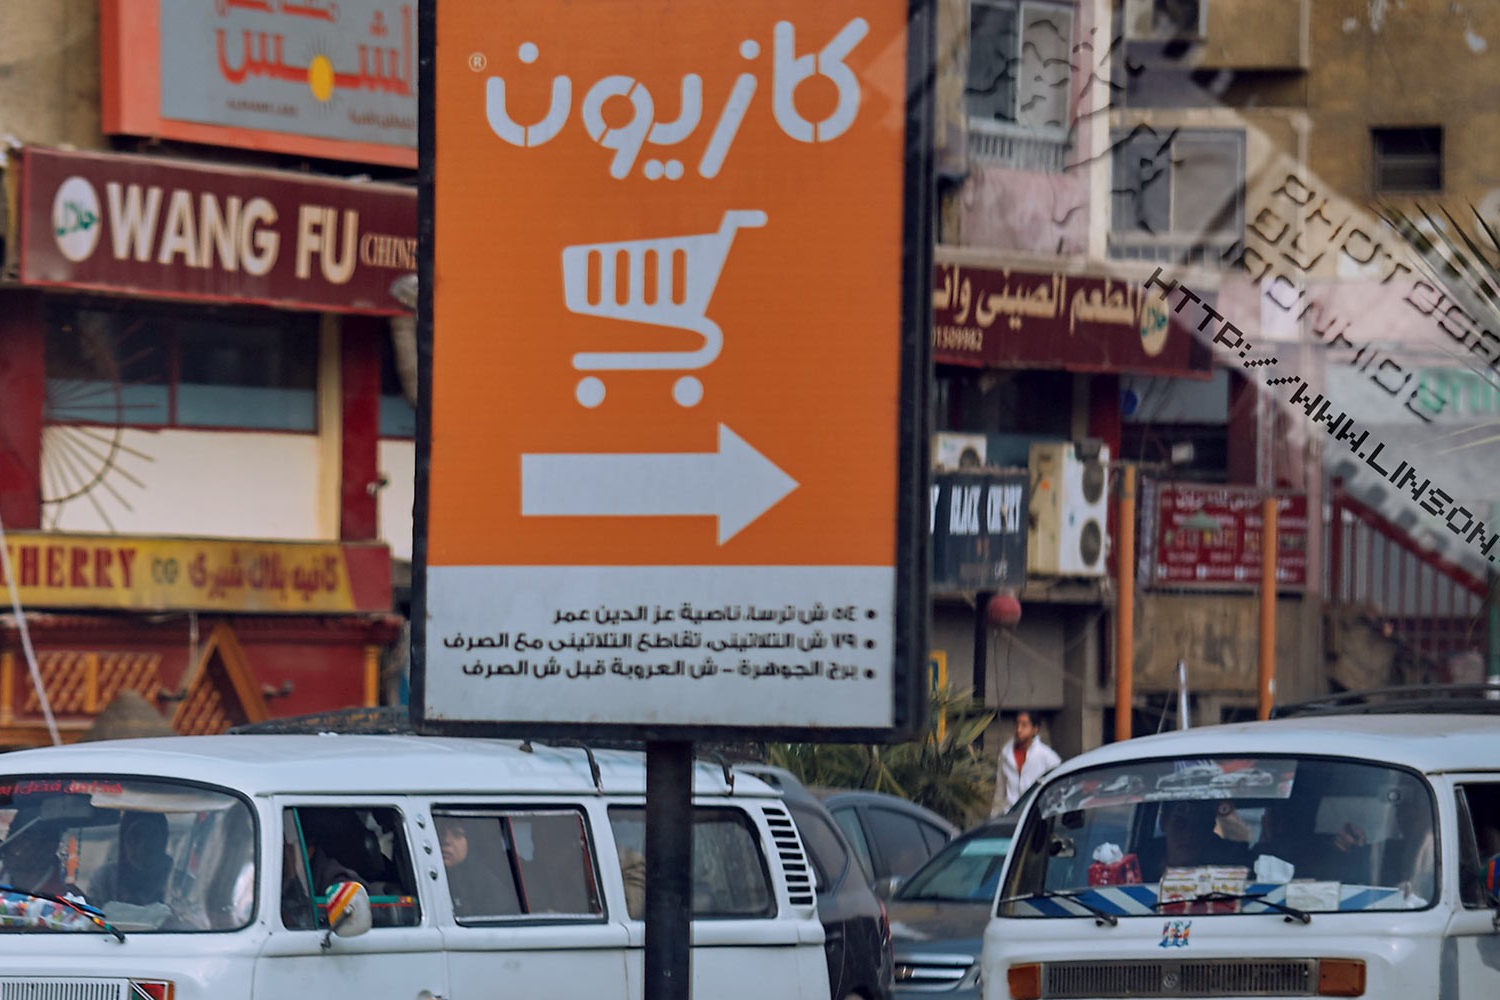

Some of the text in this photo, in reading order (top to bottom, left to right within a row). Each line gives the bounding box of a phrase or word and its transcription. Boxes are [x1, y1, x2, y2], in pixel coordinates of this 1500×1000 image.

[486, 17, 870, 180] كازيون
[106, 182, 281, 276] WANG
[295, 203, 359, 284] FU
[553, 608, 590, 624] عمر
[595, 605, 648, 624] الدين
[443, 632, 509, 651] الصرف
[514, 632, 544, 651] مع
[462, 659, 529, 679] الصرف
[566, 659, 607, 679] قبل
